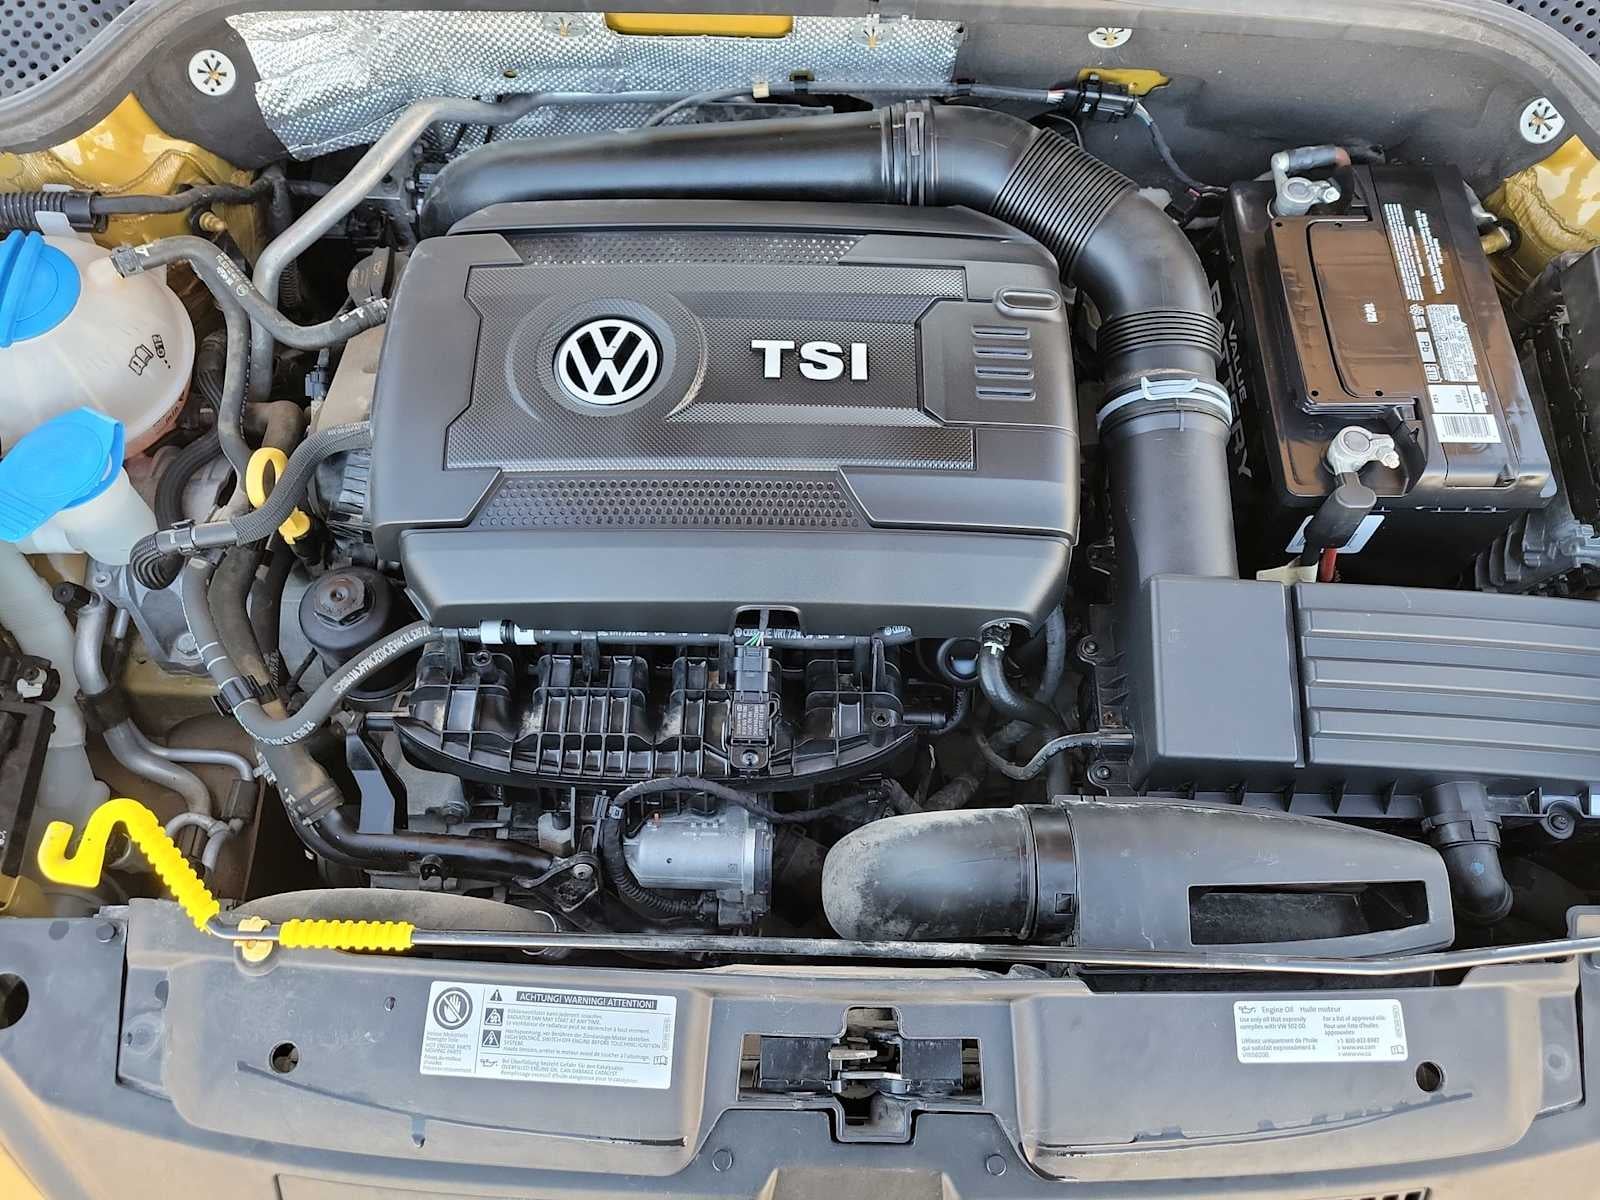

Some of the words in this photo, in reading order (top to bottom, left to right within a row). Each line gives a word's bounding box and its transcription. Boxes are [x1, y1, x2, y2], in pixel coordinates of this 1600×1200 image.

[751, 339, 868, 381] TSI
[1420, 340, 1430, 353] Pb
[558, 318, 658, 405] VW
[1228, 319, 1248, 404] VALUE
[519, 992, 562, 1004] ACHTUNG!
[563, 995, 606, 1007] WARNING!
[607, 999, 655, 1009] ATTENTION!
[1262, 1006, 1284, 1015] Engine
